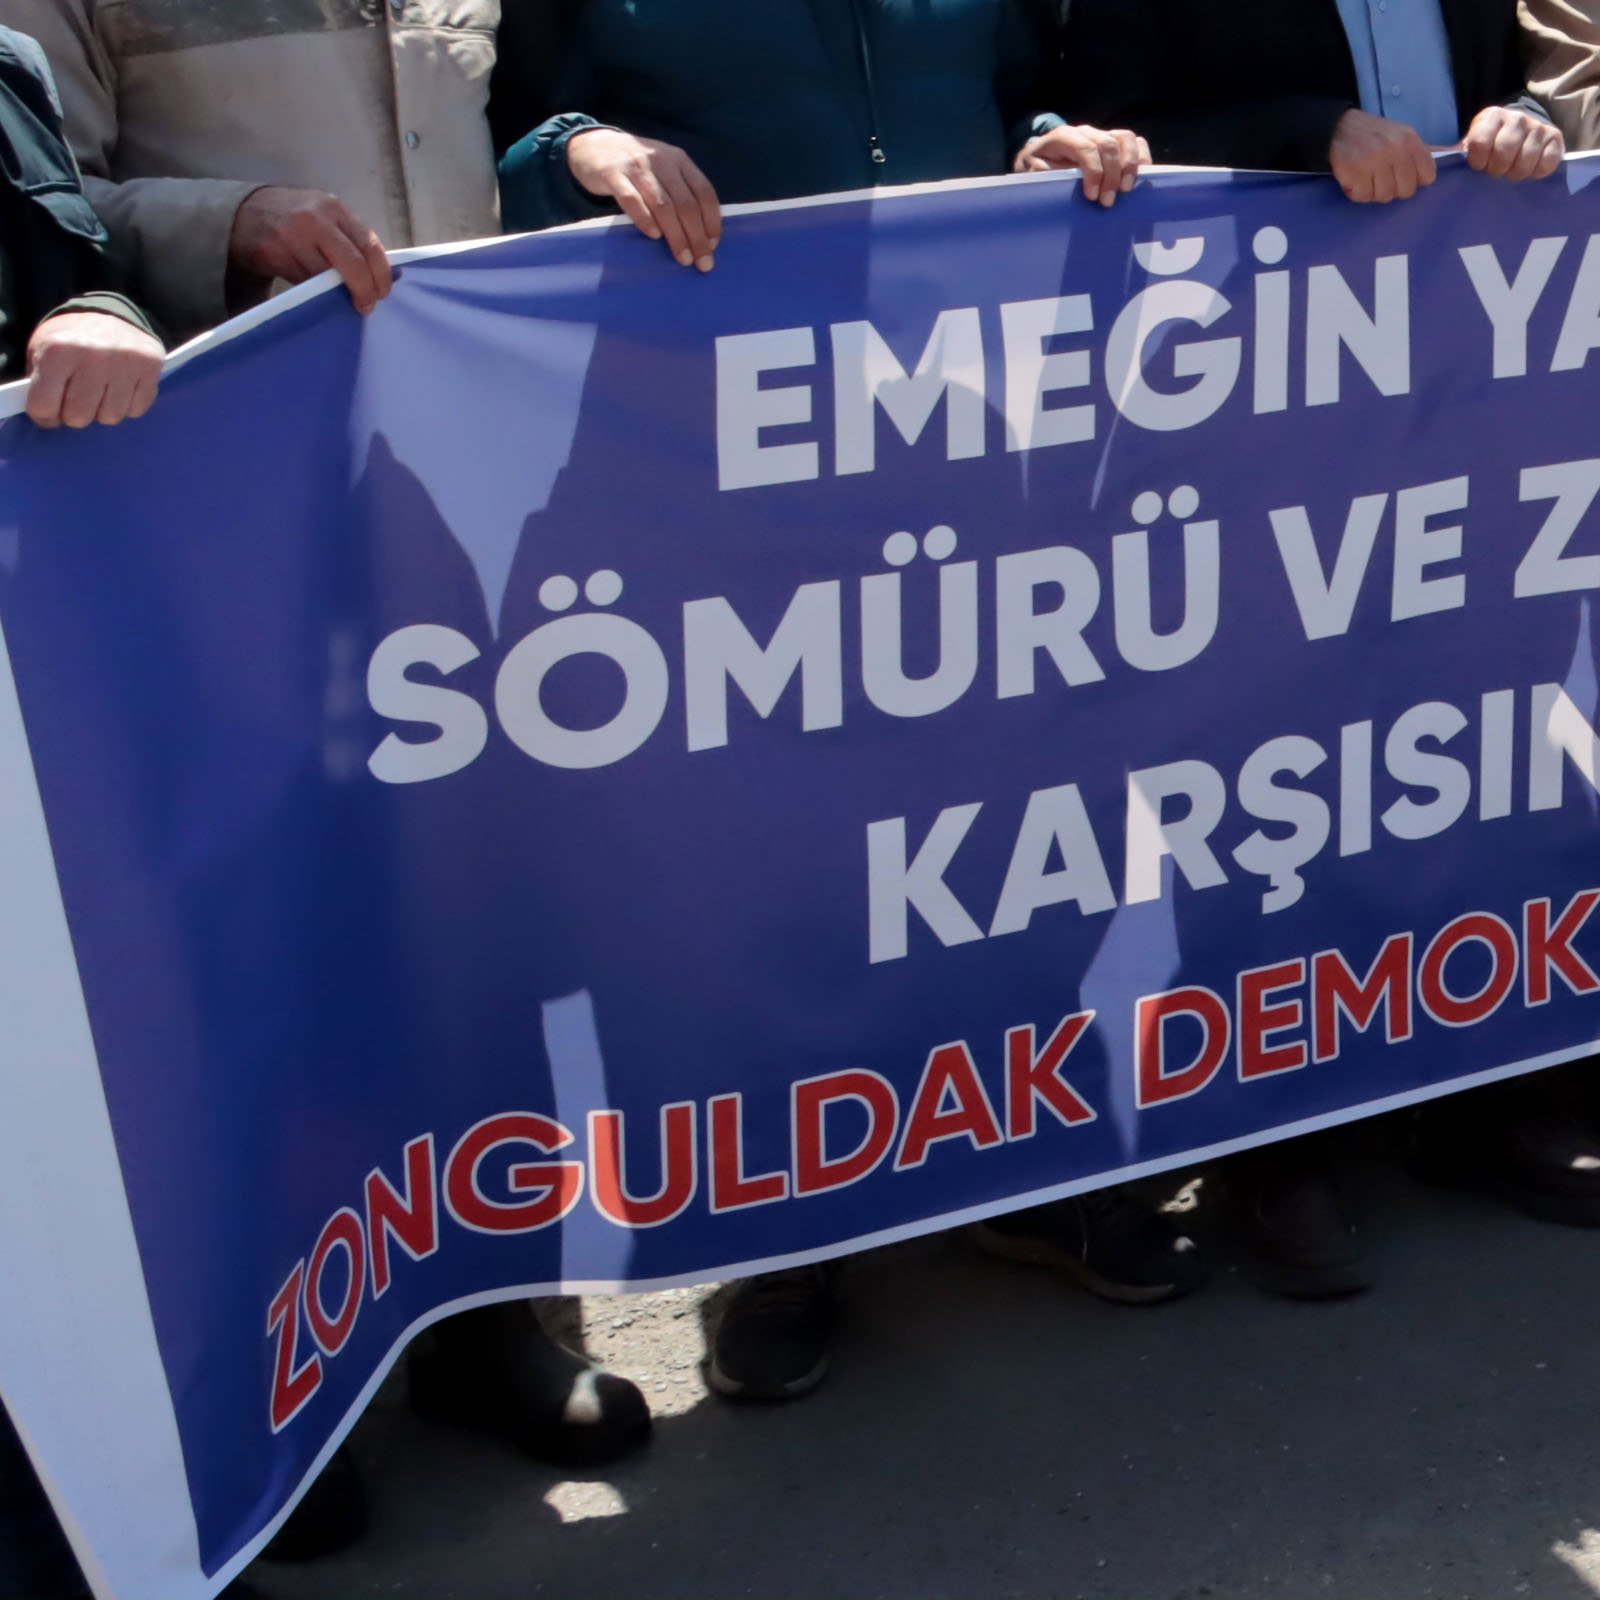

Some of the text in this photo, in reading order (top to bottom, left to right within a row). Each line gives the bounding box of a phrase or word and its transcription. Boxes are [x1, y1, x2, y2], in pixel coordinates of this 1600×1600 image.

[714, 225, 1413, 493] EMEĞİN
[366, 483, 1222, 784] SÖMÜRÜ
[1268, 475, 1470, 642] VE
[264, 1010, 1100, 1437] ZONGULDAK
